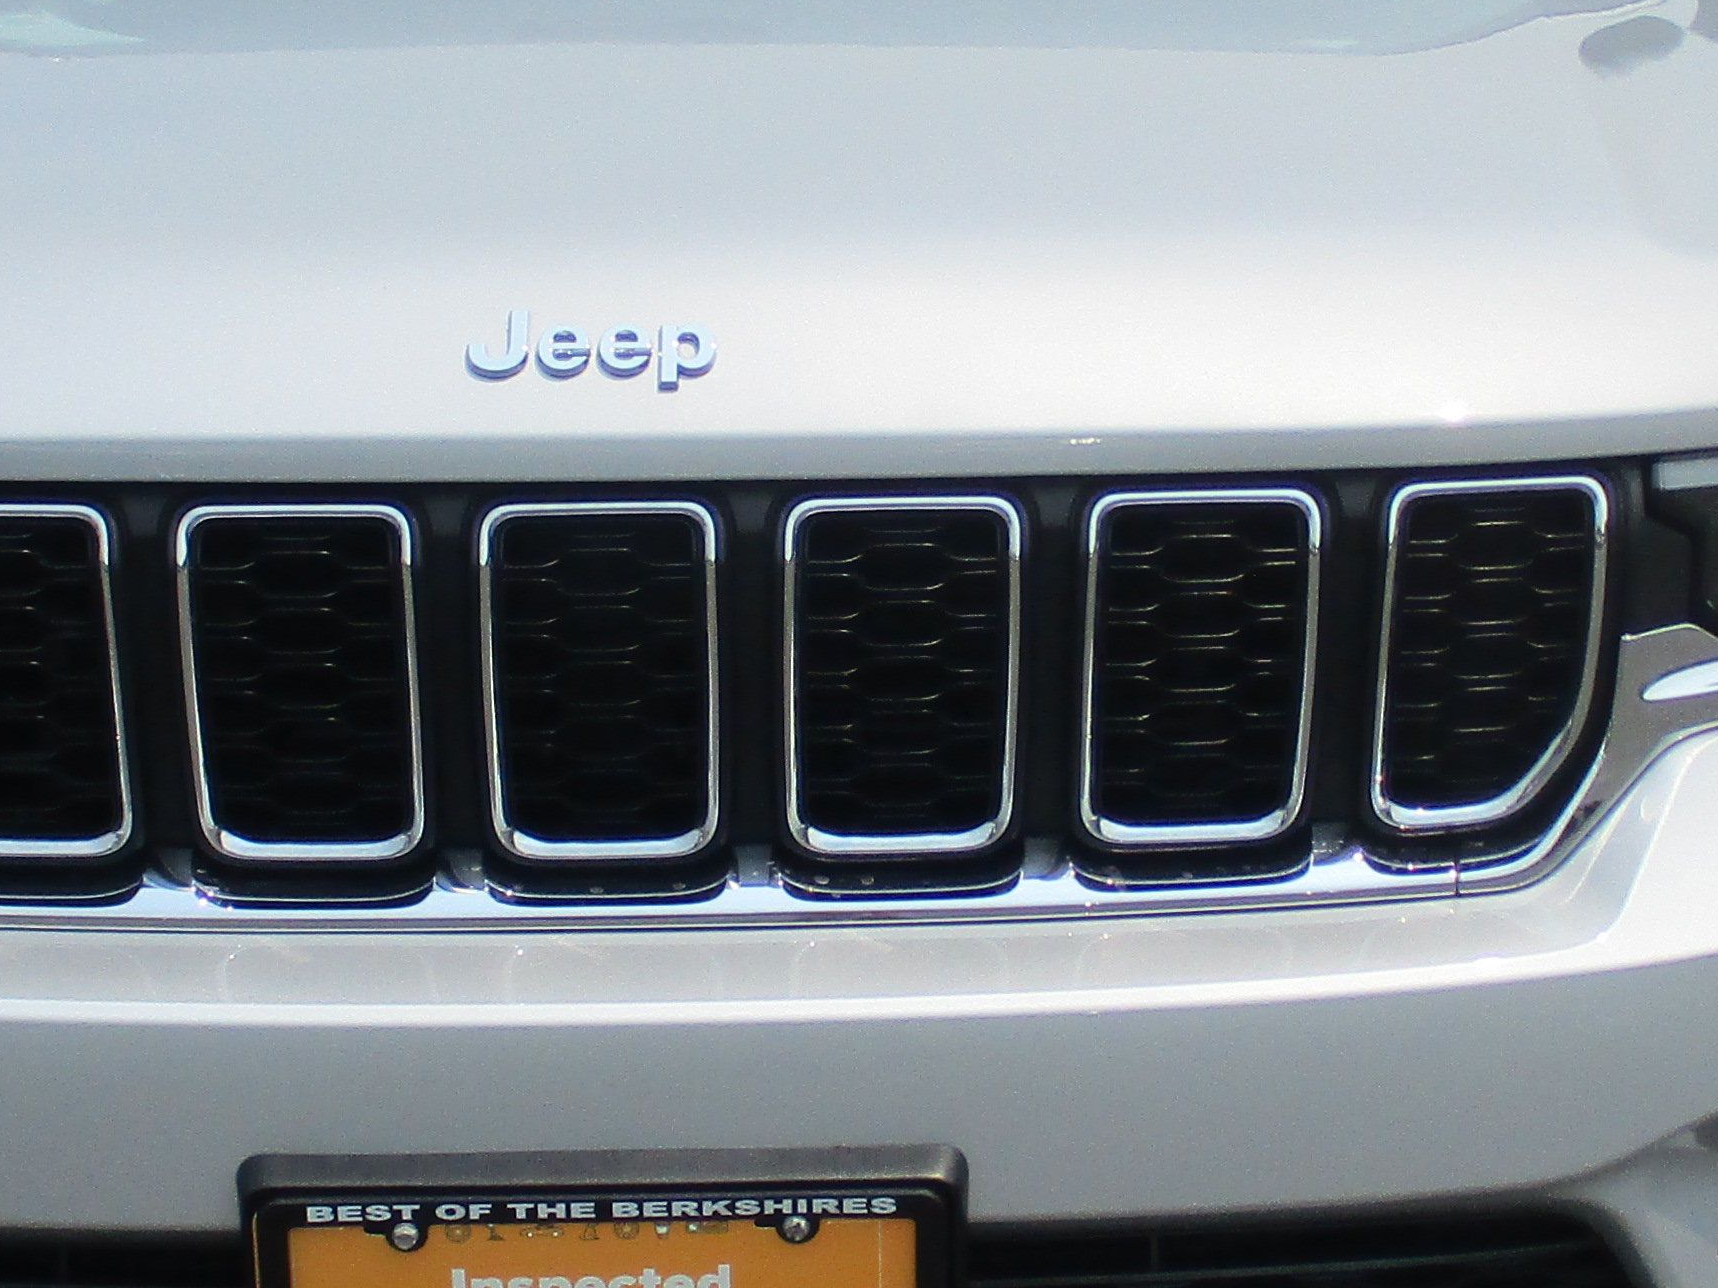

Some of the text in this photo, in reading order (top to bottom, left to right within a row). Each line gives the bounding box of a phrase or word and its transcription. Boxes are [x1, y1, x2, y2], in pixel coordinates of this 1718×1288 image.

[463, 310, 717, 393] Jeep
[306, 1197, 898, 1223] BEST OF THE BERKSHIRES
